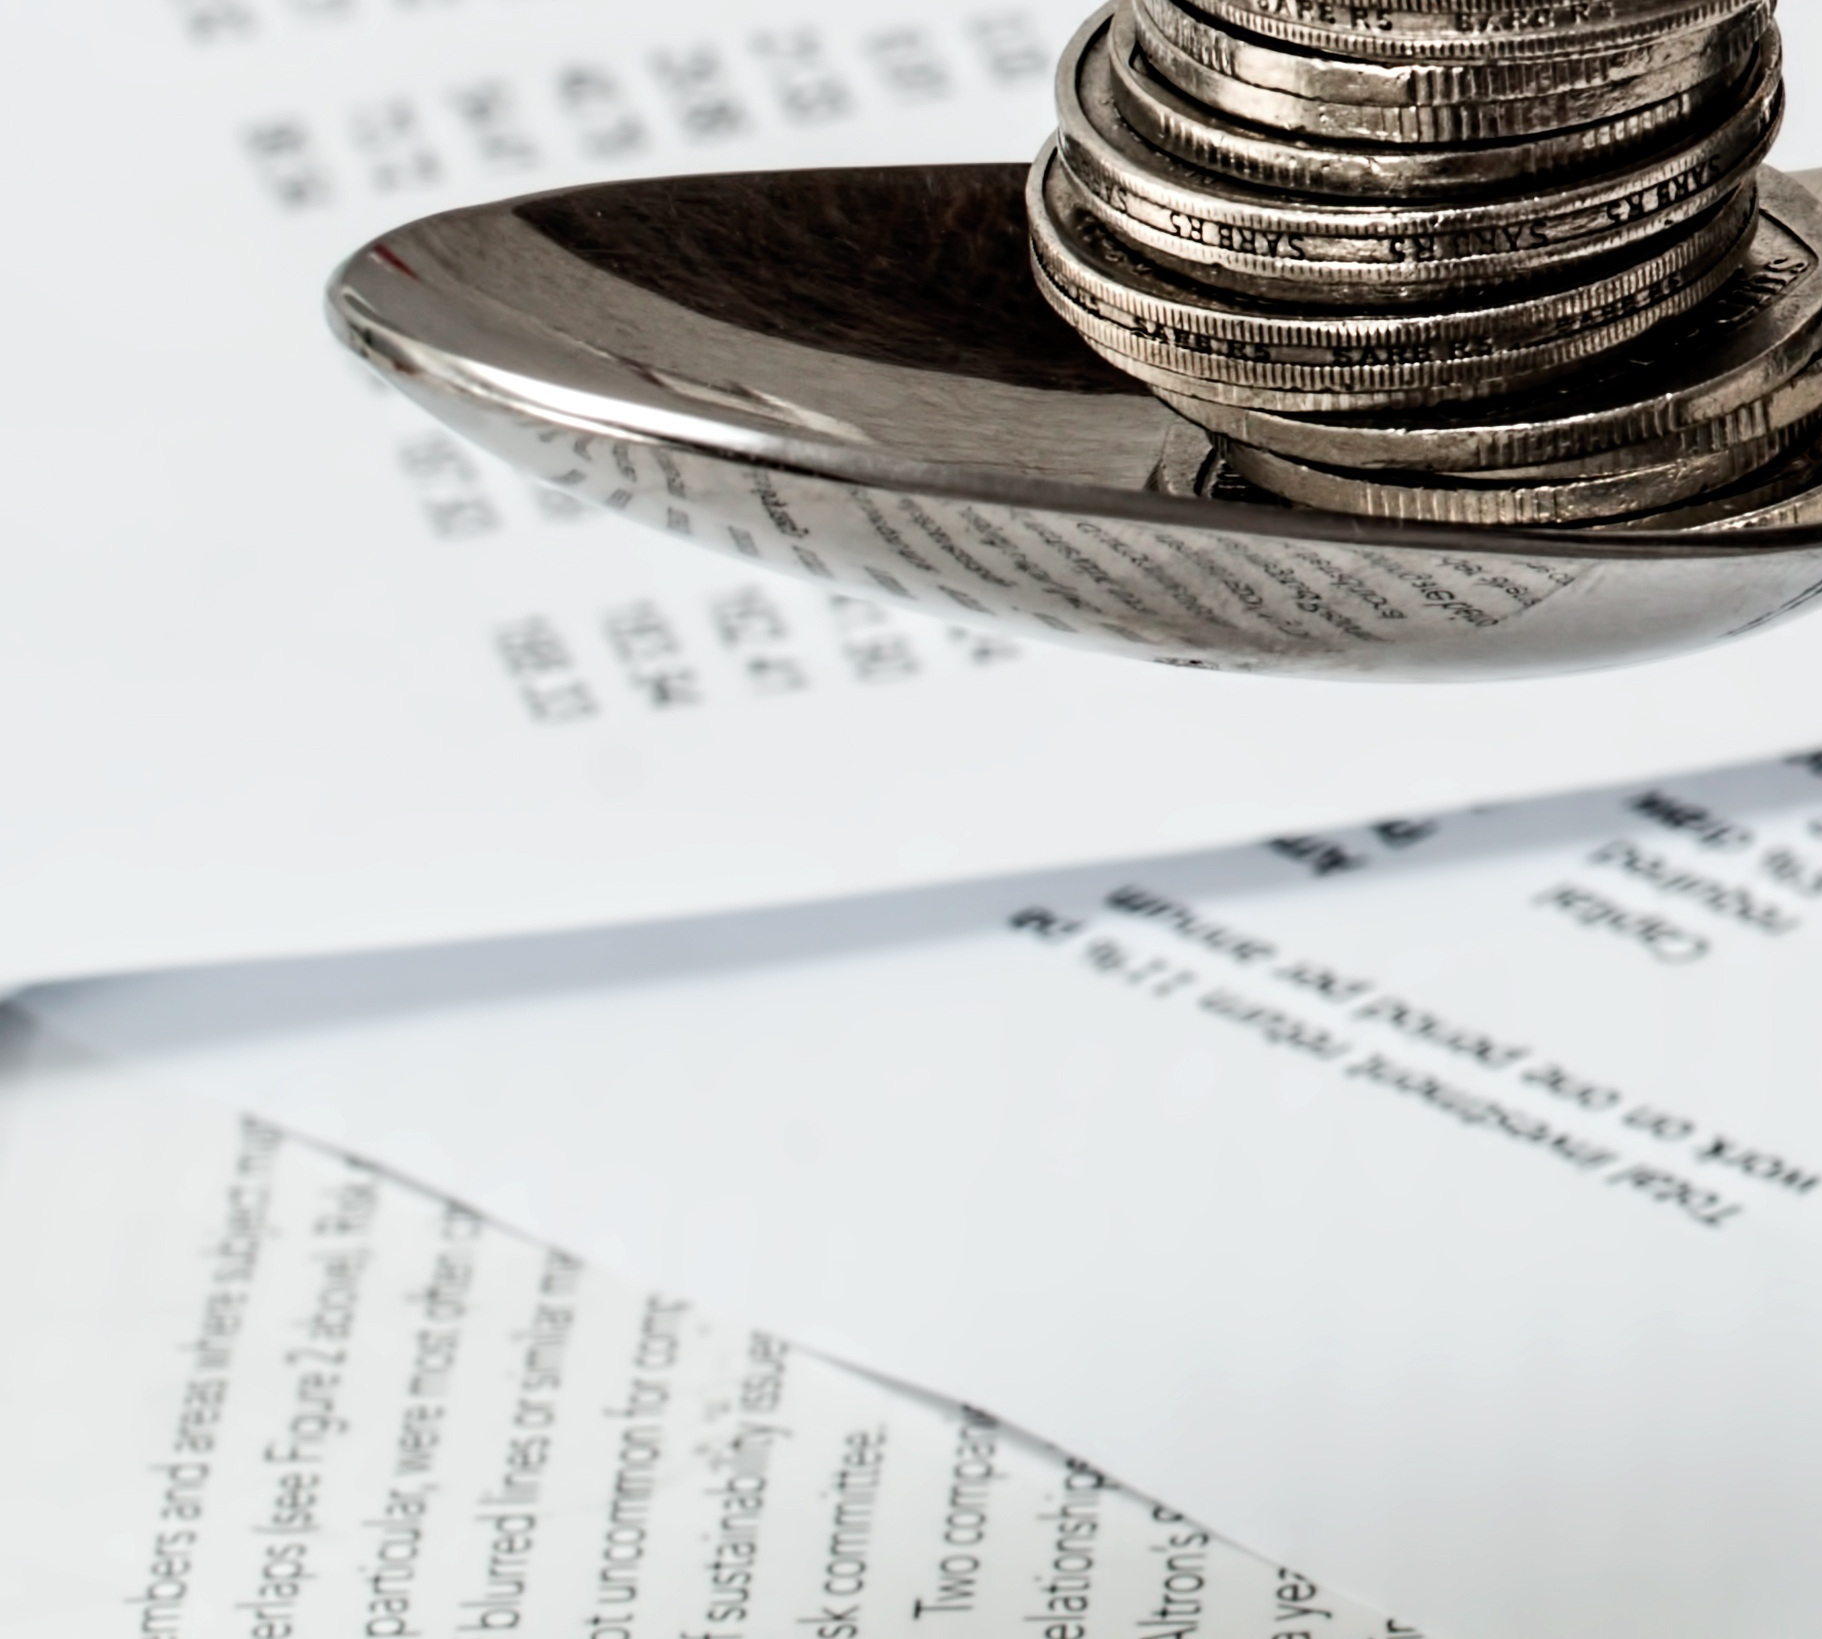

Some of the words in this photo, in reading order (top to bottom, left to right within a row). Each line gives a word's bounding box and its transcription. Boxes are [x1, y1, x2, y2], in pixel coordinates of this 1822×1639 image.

[1219, 224, 1305, 260] SARB
[1104, 884, 1278, 964] annum
[1534, 881, 1709, 966] Capital
[1271, 957, 1375, 1003] per
[1198, 988, 1353, 1061] return
[1351, 994, 1531, 1070] period
[1344, 1052, 1618, 1171] investment
[1519, 1062, 1622, 1112] one
[1621, 1104, 1696, 1144] on
[1604, 1162, 1745, 1229] Total
[1694, 1134, 1822, 1195] work
[264, 1373, 349, 1468] Figure
[149, 1460, 210, 1528] and
[599, 1426, 661, 1605] uncommon
[361, 1478, 442, 1639] particular,
[458, 1490, 537, 1634] blurred
[912, 1556, 982, 1623] Two
